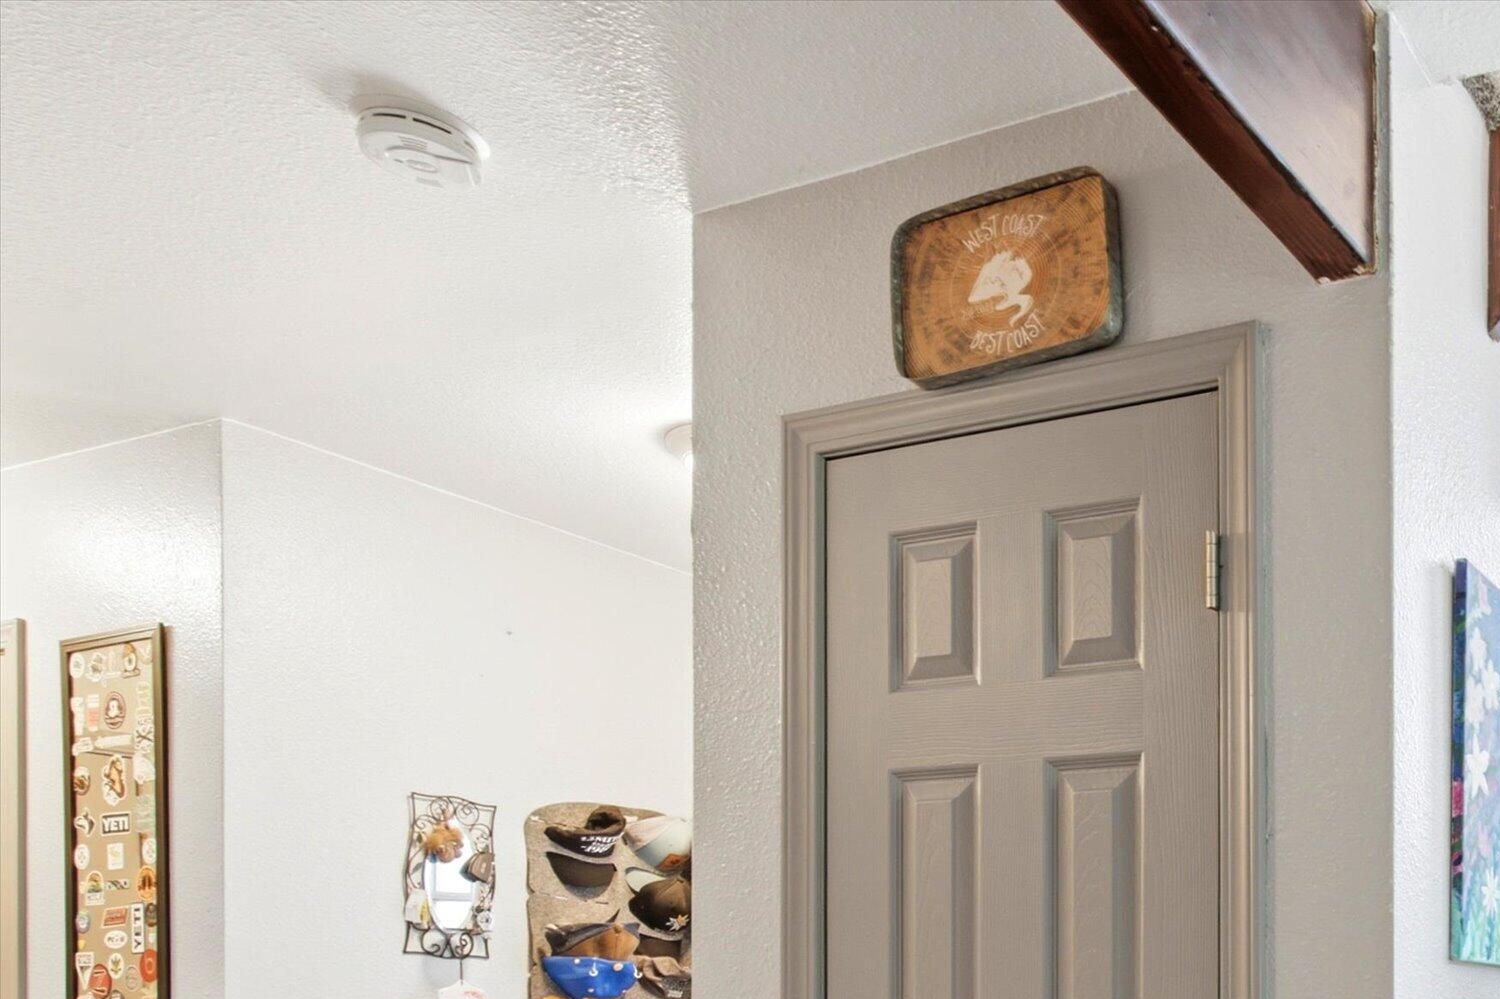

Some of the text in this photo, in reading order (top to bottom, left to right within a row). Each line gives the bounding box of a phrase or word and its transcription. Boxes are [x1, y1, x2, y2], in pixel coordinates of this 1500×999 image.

[962, 213, 1047, 253] WEST COAST
[969, 309, 1047, 354] BEST COAST
[102, 816, 129, 832] YETI
[133, 907, 142, 950] YETI
